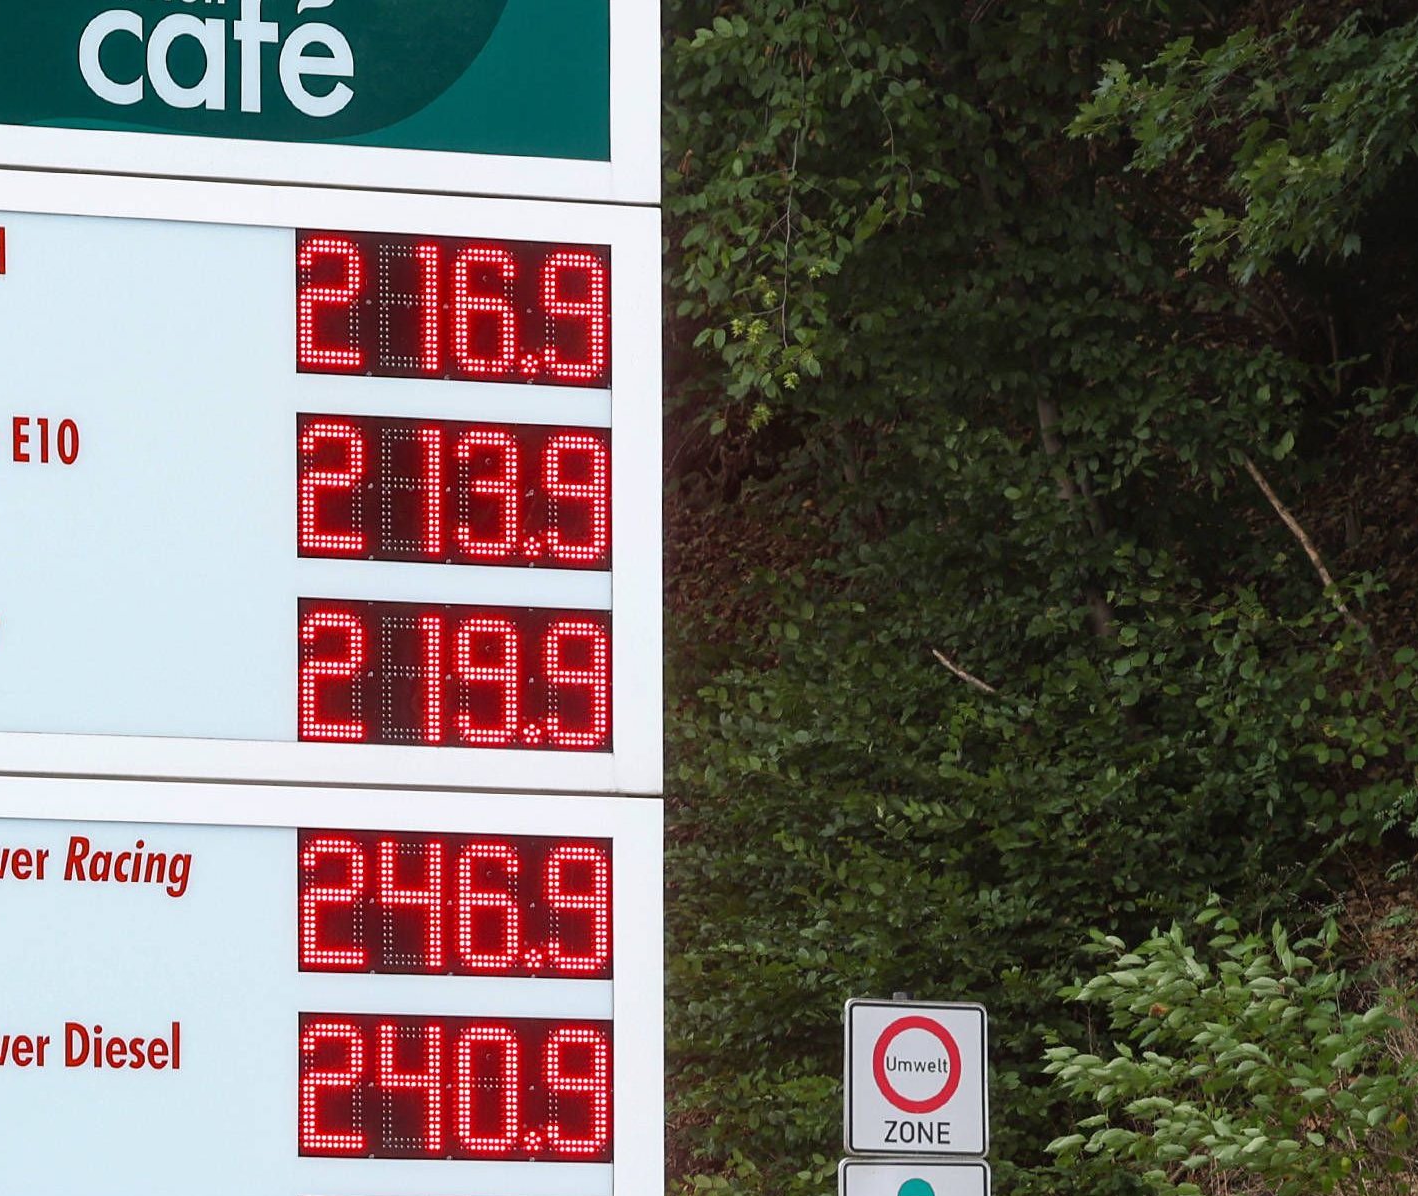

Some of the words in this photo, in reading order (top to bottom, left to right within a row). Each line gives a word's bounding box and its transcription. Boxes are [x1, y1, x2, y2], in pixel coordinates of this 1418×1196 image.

[299, 239, 605, 379] 216.9
[13, 417, 80, 465] E10
[300, 423, 607, 561] 213.9
[300, 611, 607, 747] 219.9
[64, 836, 192, 897] Racing
[300, 838, 608, 973] 246.9
[65, 1021, 181, 1070] Diesel
[300, 1022, 608, 1155] 240.9
[885, 1055, 949, 1074] Umwelt
[884, 1120, 951, 1145] ZONE
